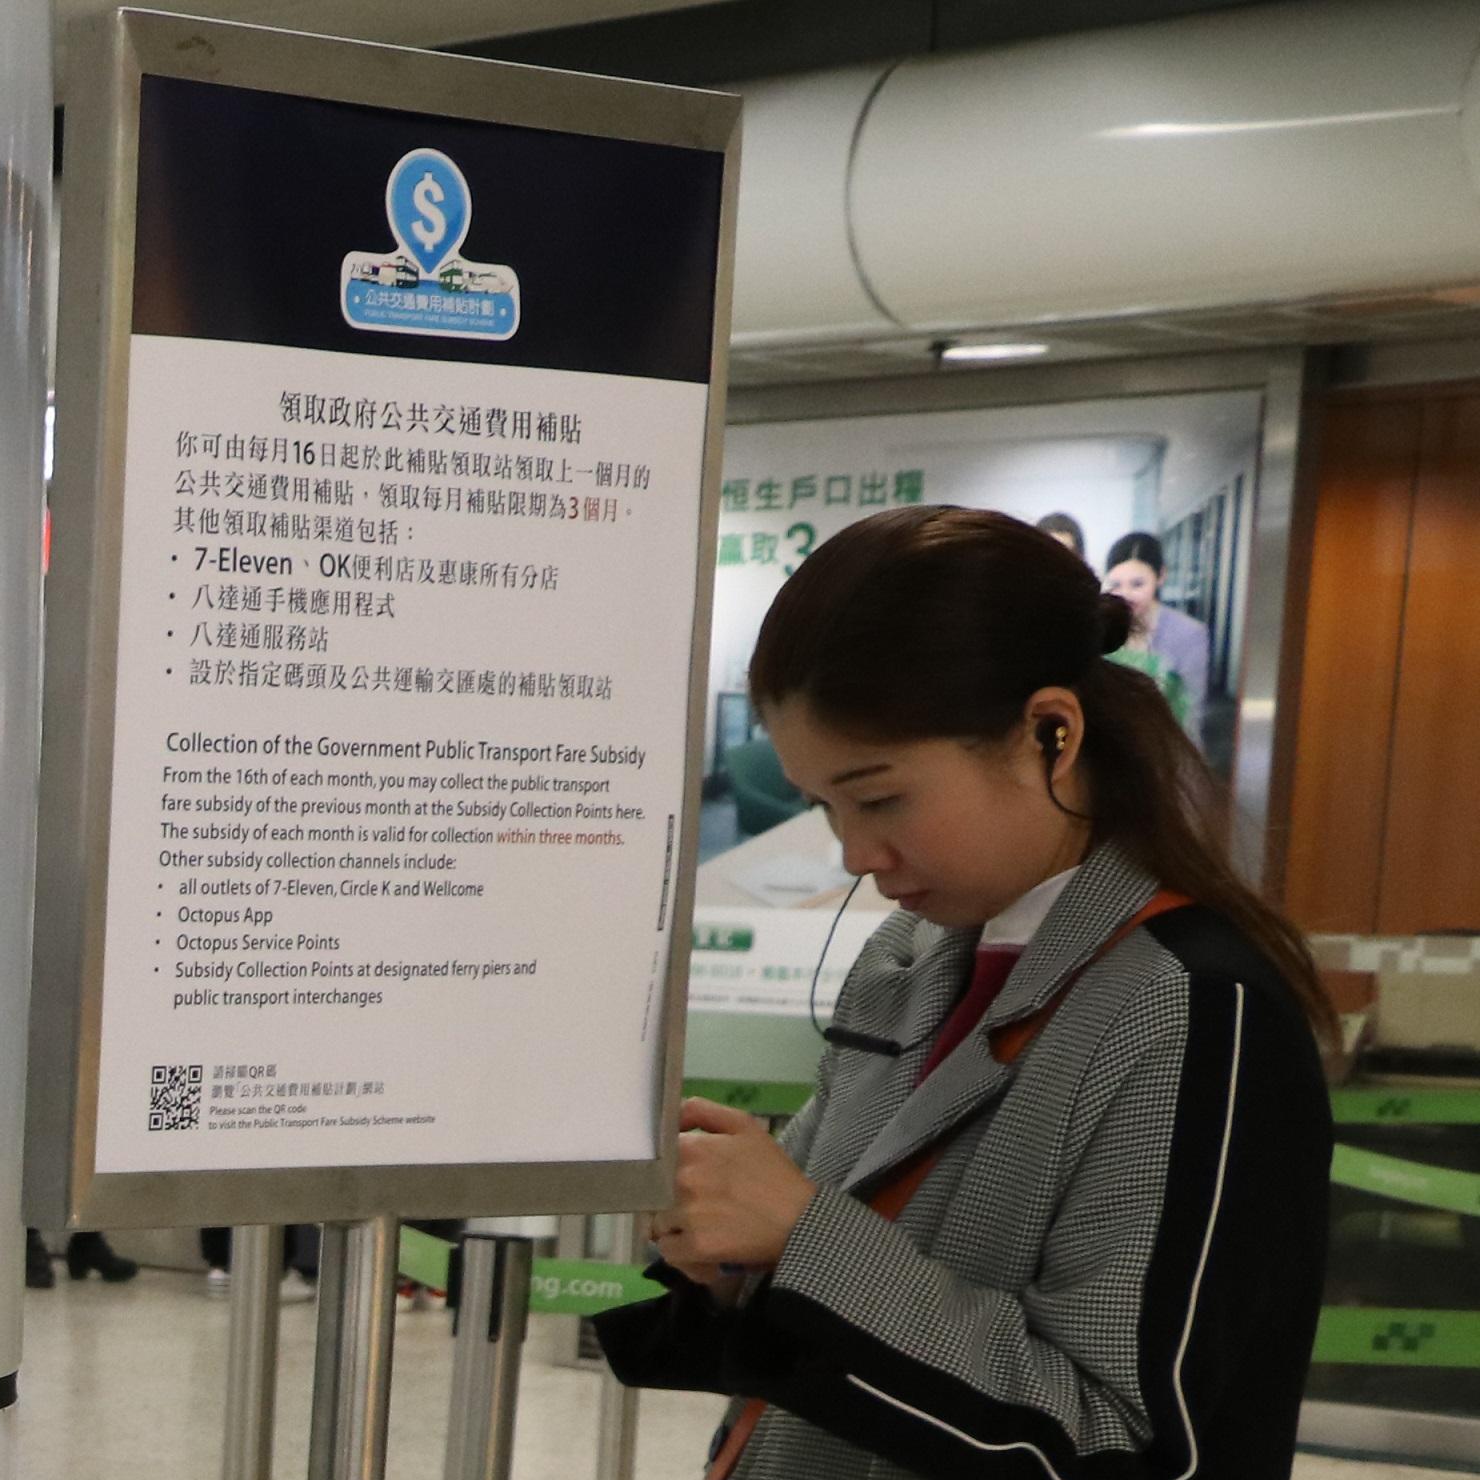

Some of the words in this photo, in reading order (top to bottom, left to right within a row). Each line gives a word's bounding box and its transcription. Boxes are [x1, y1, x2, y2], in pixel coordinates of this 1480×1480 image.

[279, 390, 582, 445] 領取政府公共交通費用補貼
[191, 583, 396, 619] 八達通手機應用程式
[190, 620, 329, 653] 八達通服務站
[167, 731, 257, 754] Collection
[263, 734, 281, 755] of
[285, 735, 312, 755] the
[318, 736, 421, 758] Government
[426, 739, 474, 760] Public
[478, 741, 551, 766] Transport
[556, 743, 586, 763] Fare
[590, 745, 645, 769] Subsidy
[162, 793, 191, 812] fare
[196, 795, 252, 817] subsidy
[256, 796, 271, 813] of
[274, 796, 297, 813] the
[301, 798, 361, 817] previous
[365, 799, 410, 815] month
[415, 802, 428, 815] at
[432, 800, 453, 816] the
[457, 800, 506, 821] Subsidy
[510, 801, 571, 818] Collection
[576, 802, 612, 819] Points
[616, 804, 645, 820] here.
[159, 850, 203, 868] Other
[208, 850, 263, 872] subsidy
[267, 851, 335, 869] collection
[339, 852, 400, 870] channels
[404, 853, 456, 870] include:
[179, 878, 196, 895] all
[201, 879, 251, 895] outlets
[255, 878, 270, 895] of
[274, 879, 337, 897] 7-Eleven,
[340, 879, 378, 896] Circle
[382, 880, 390, 896] K
[394, 881, 420, 897] and
[424, 880, 483, 896] Wellcome
[178, 906, 239, 926] Octopus
[244, 906, 272, 926] App
[177, 934, 237, 955] Octopus
[243, 934, 293, 951] Service
[297, 934, 339, 950] Points
[176, 960, 233, 982] Subsidy
[237, 961, 307, 978] Collection
[312, 961, 353, 977] Points
[358, 963, 370, 977] at
[374, 960, 448, 982] designated
[452, 960, 479, 980] ferry
[482, 964, 510, 979] piers
[514, 960, 536, 975] and
[174, 989, 219, 1009] public
[223, 990, 289, 1009] transport
[293, 988, 382, 1009] interchanges
